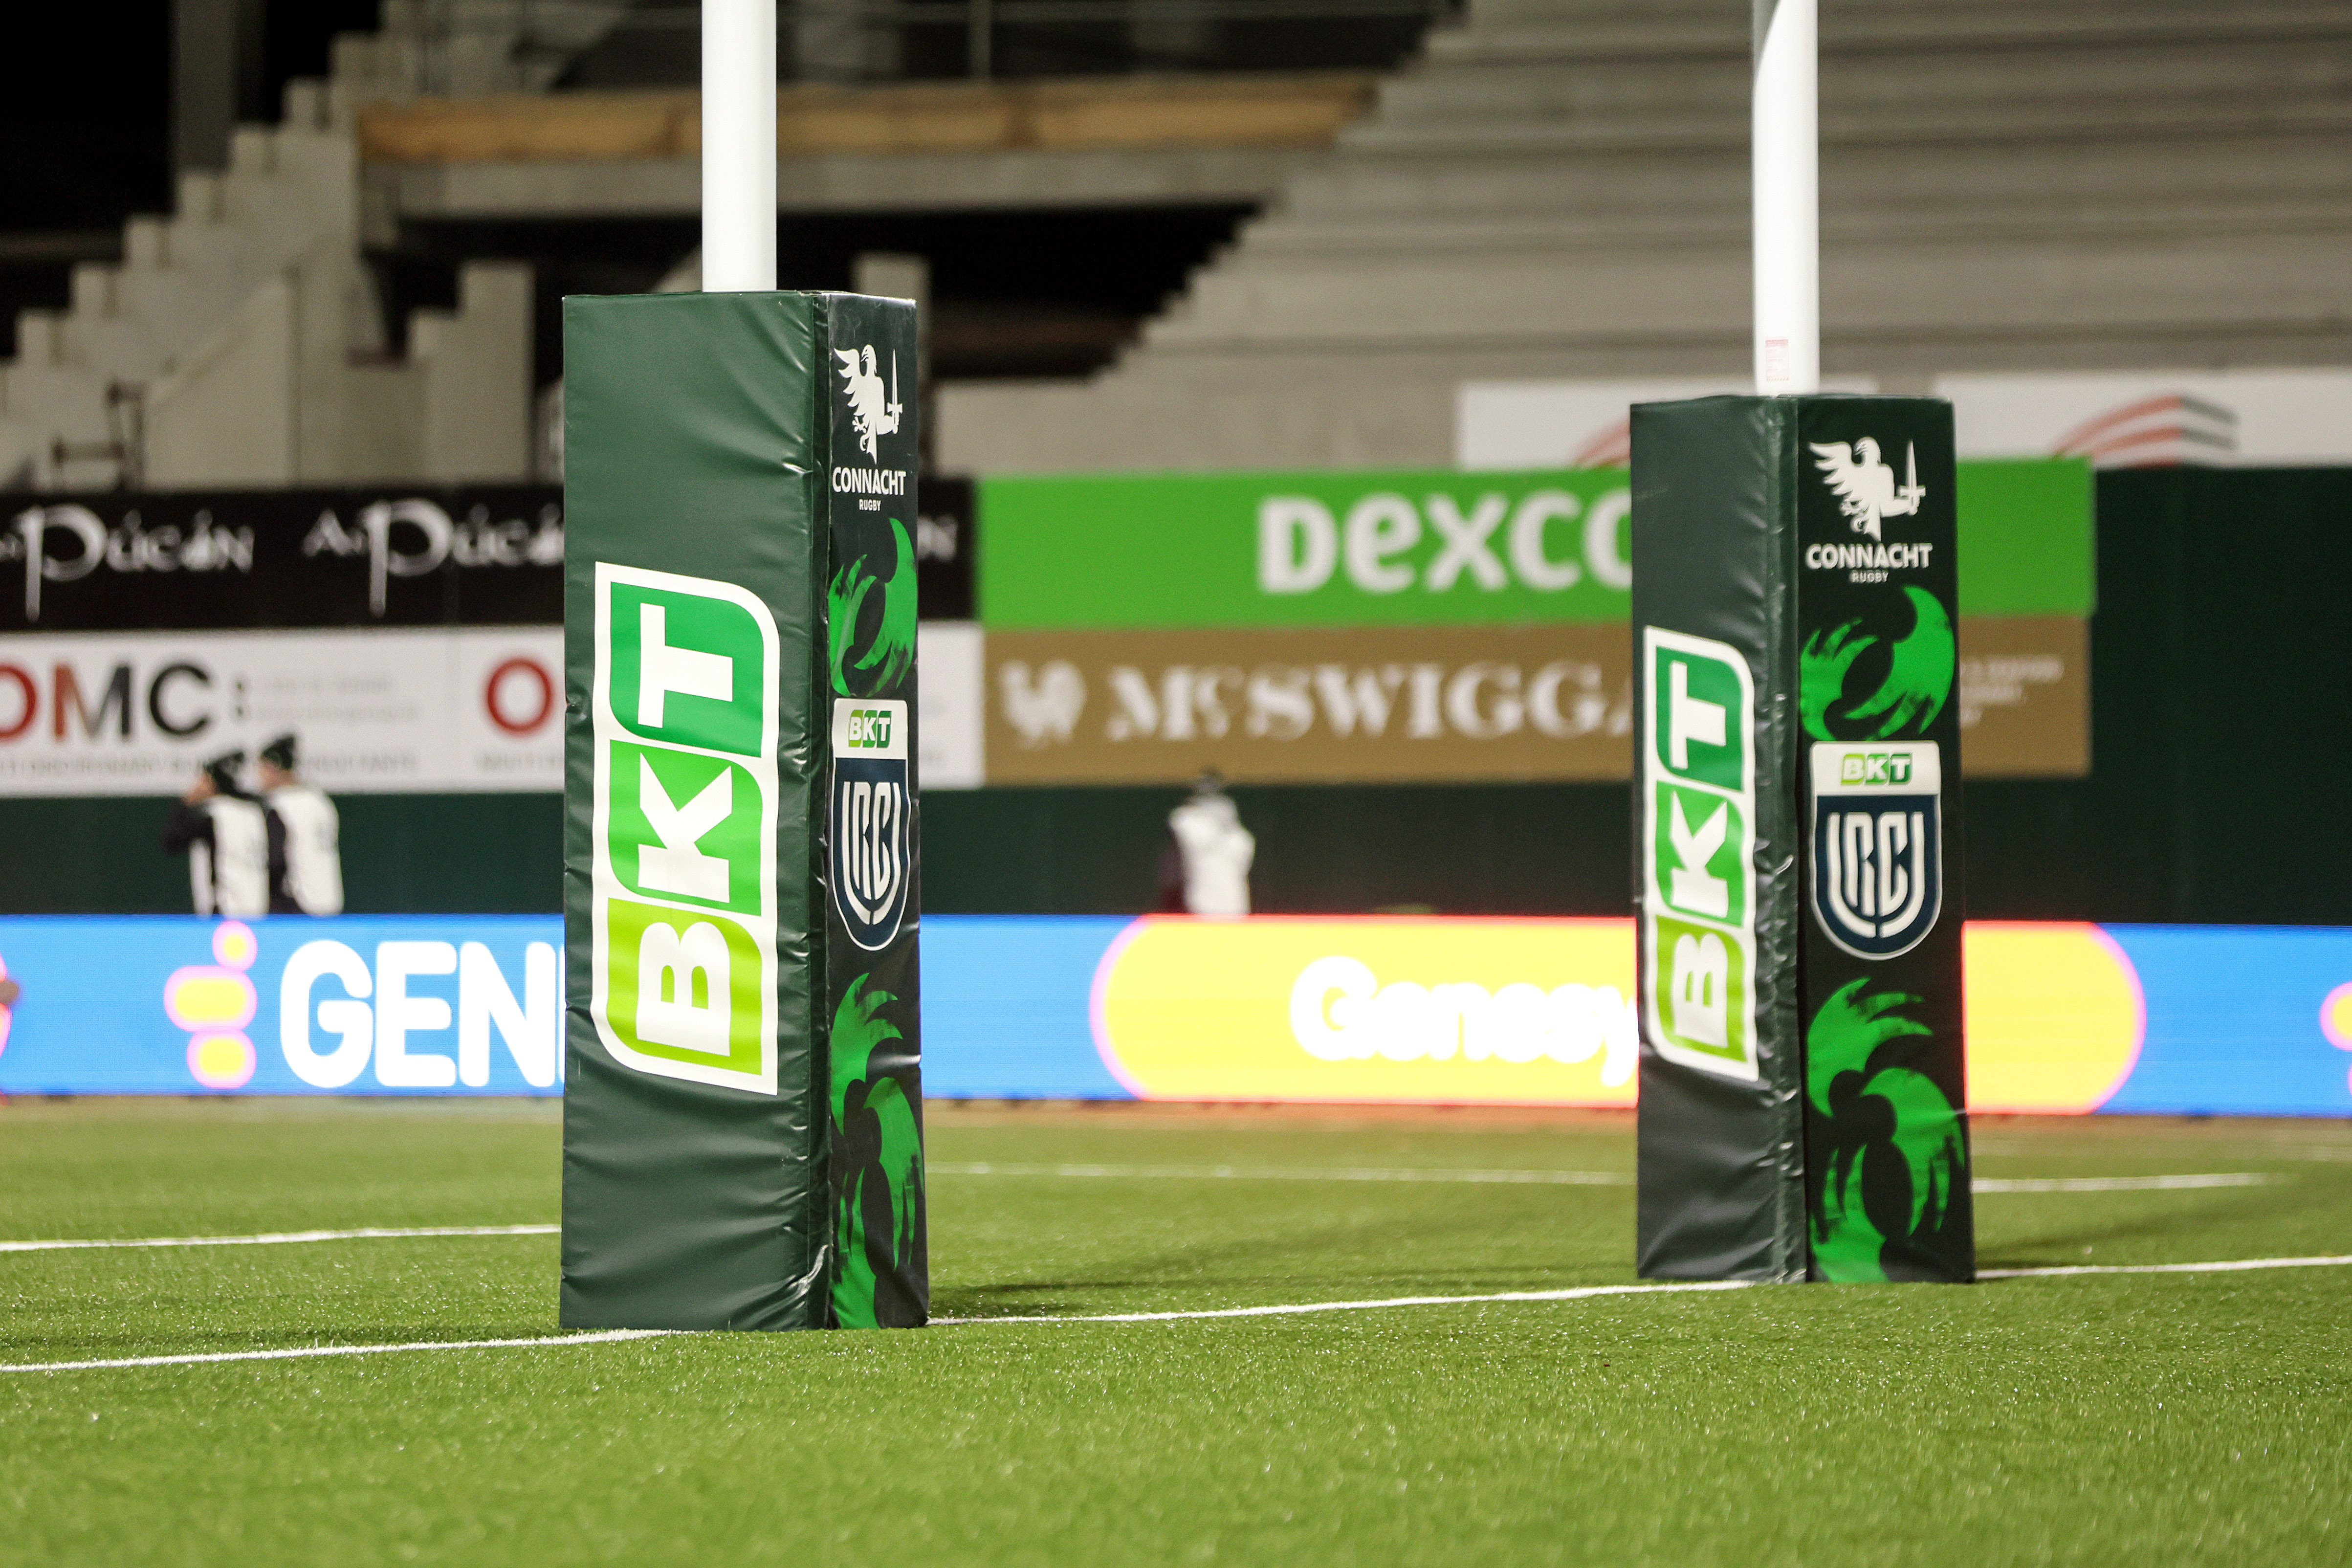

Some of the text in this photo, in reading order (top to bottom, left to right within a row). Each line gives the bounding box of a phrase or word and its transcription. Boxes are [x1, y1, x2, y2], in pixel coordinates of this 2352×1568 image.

[832, 466, 906, 496] CONNACHT
[859, 499, 881, 511] RUGBY
[1806, 543, 1933, 569] CONNACHT
[1849, 570, 1889, 583] RUGBY
[849, 714, 891, 744] BKT
[1842, 755, 1911, 783] BKT
[618, 593, 750, 1065] BKT
[1663, 653, 1737, 1055] BKT
[280, 940, 564, 1088] GEN
